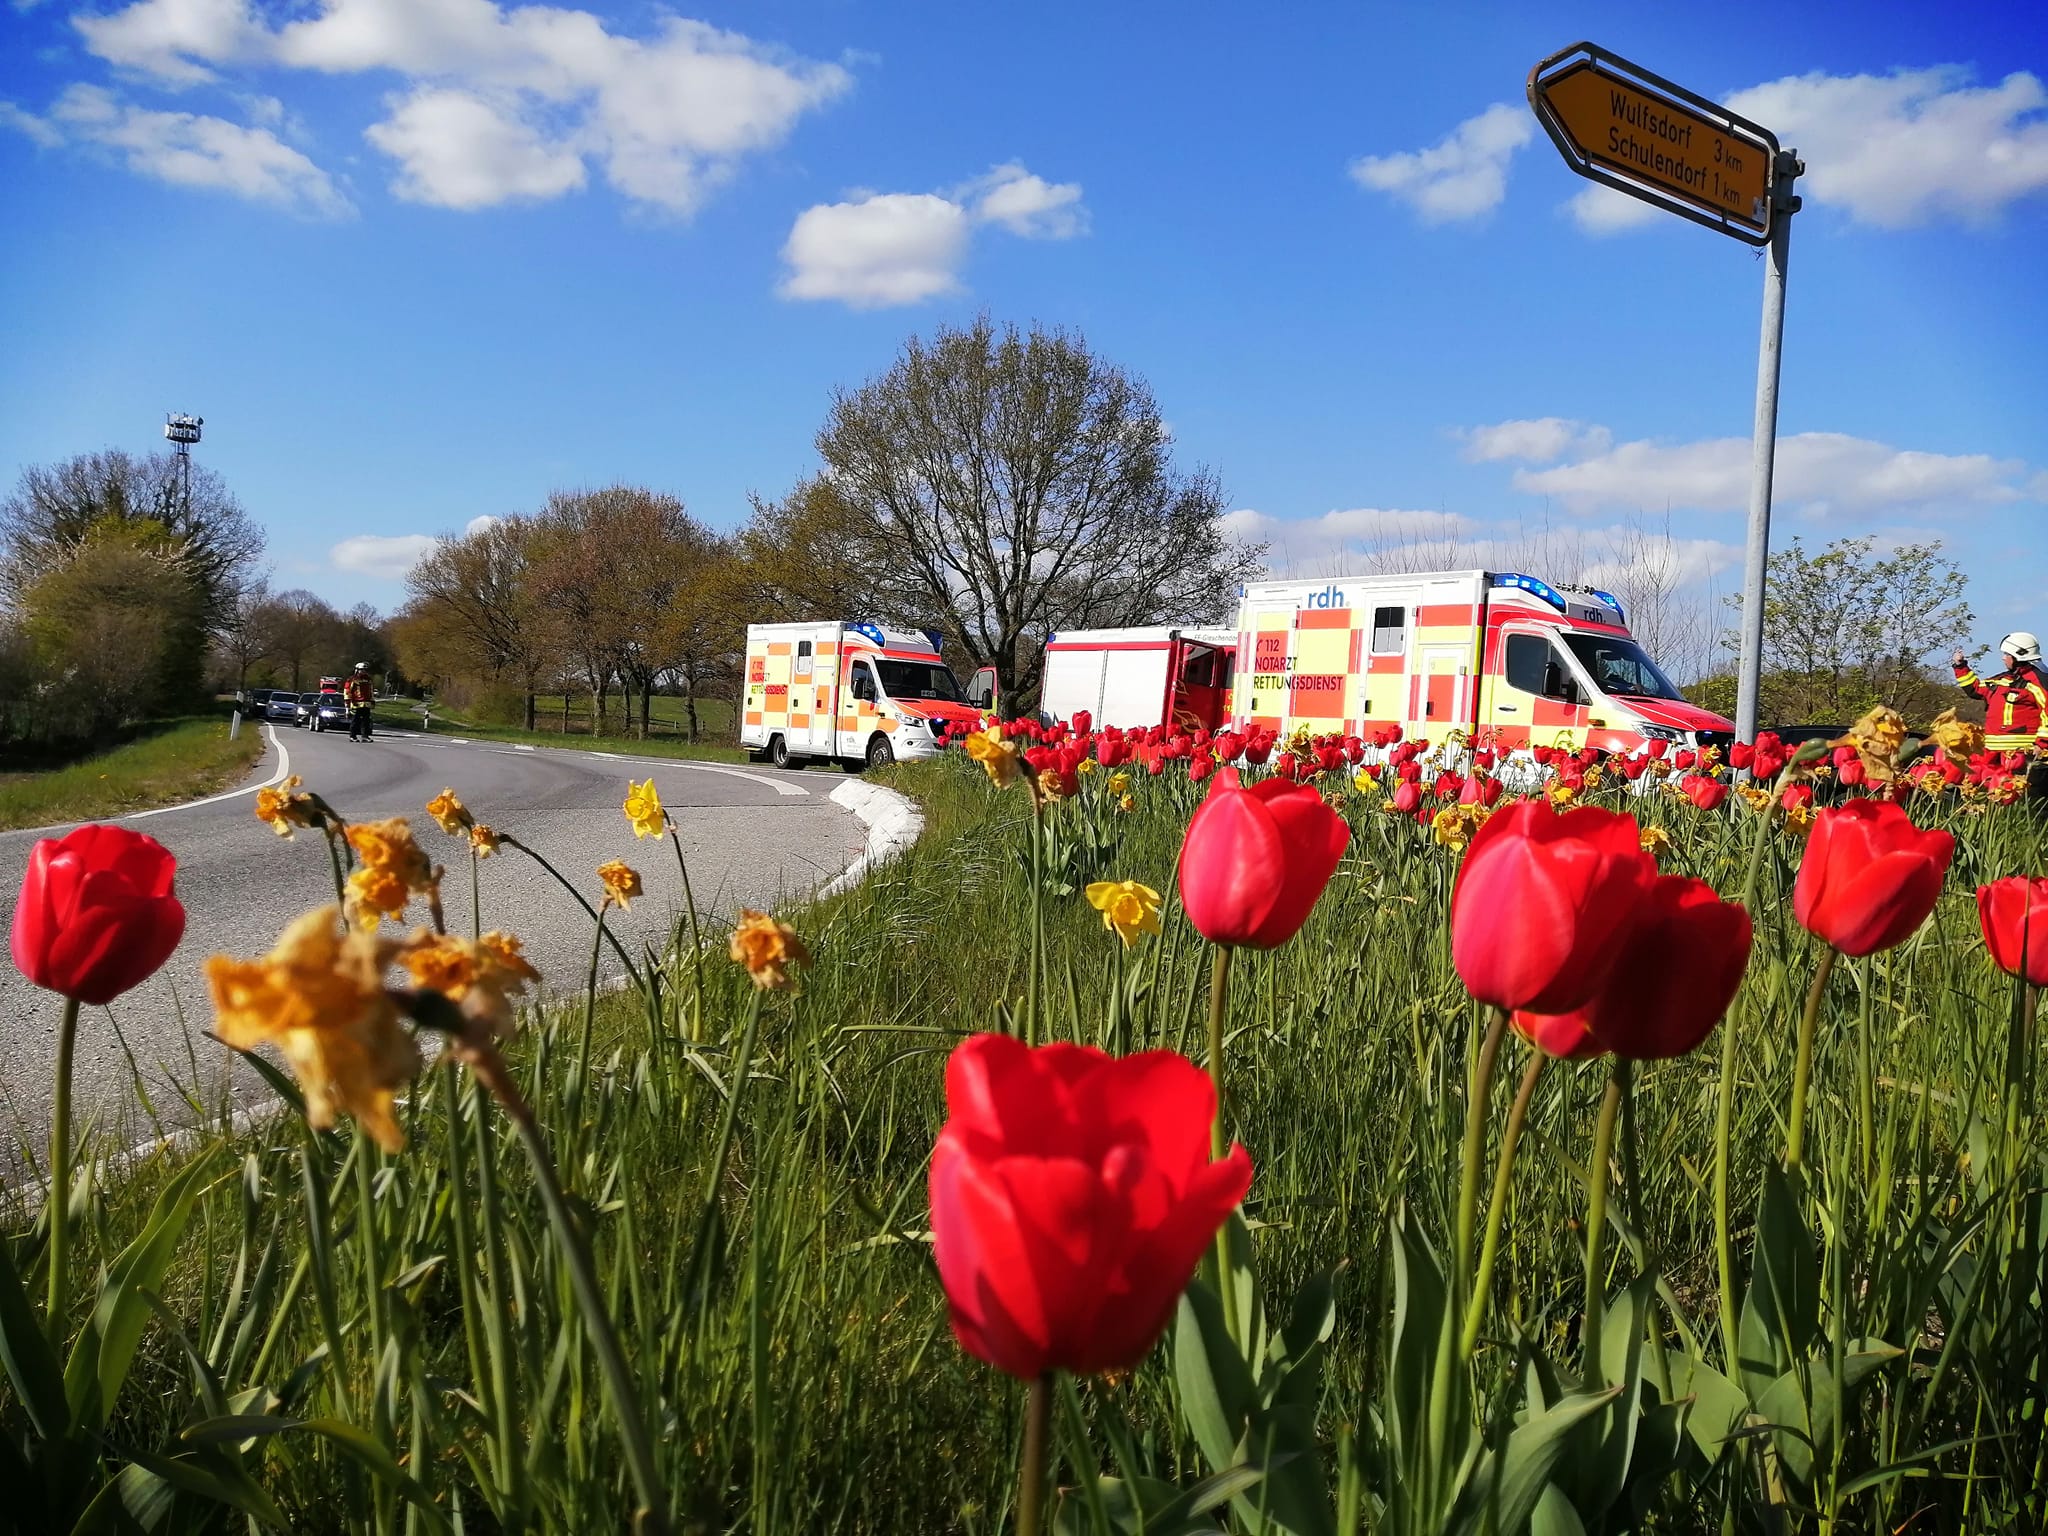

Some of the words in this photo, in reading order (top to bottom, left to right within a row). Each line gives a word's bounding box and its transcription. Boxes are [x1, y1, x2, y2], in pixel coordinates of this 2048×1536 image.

[1610, 89, 1692, 149] Wulfsdorf
[1714, 138, 1722, 163] 3
[1725, 148, 1743, 174] km
[1608, 126, 1707, 191] Schulendorf
[1714, 172, 1719, 196] 1
[1723, 181, 1740, 206] km
[1266, 638, 1280, 652] 112
[1255, 656, 1298, 671] NOTARZT
[1253, 675, 1343, 690] RETTUNGSDIENST
